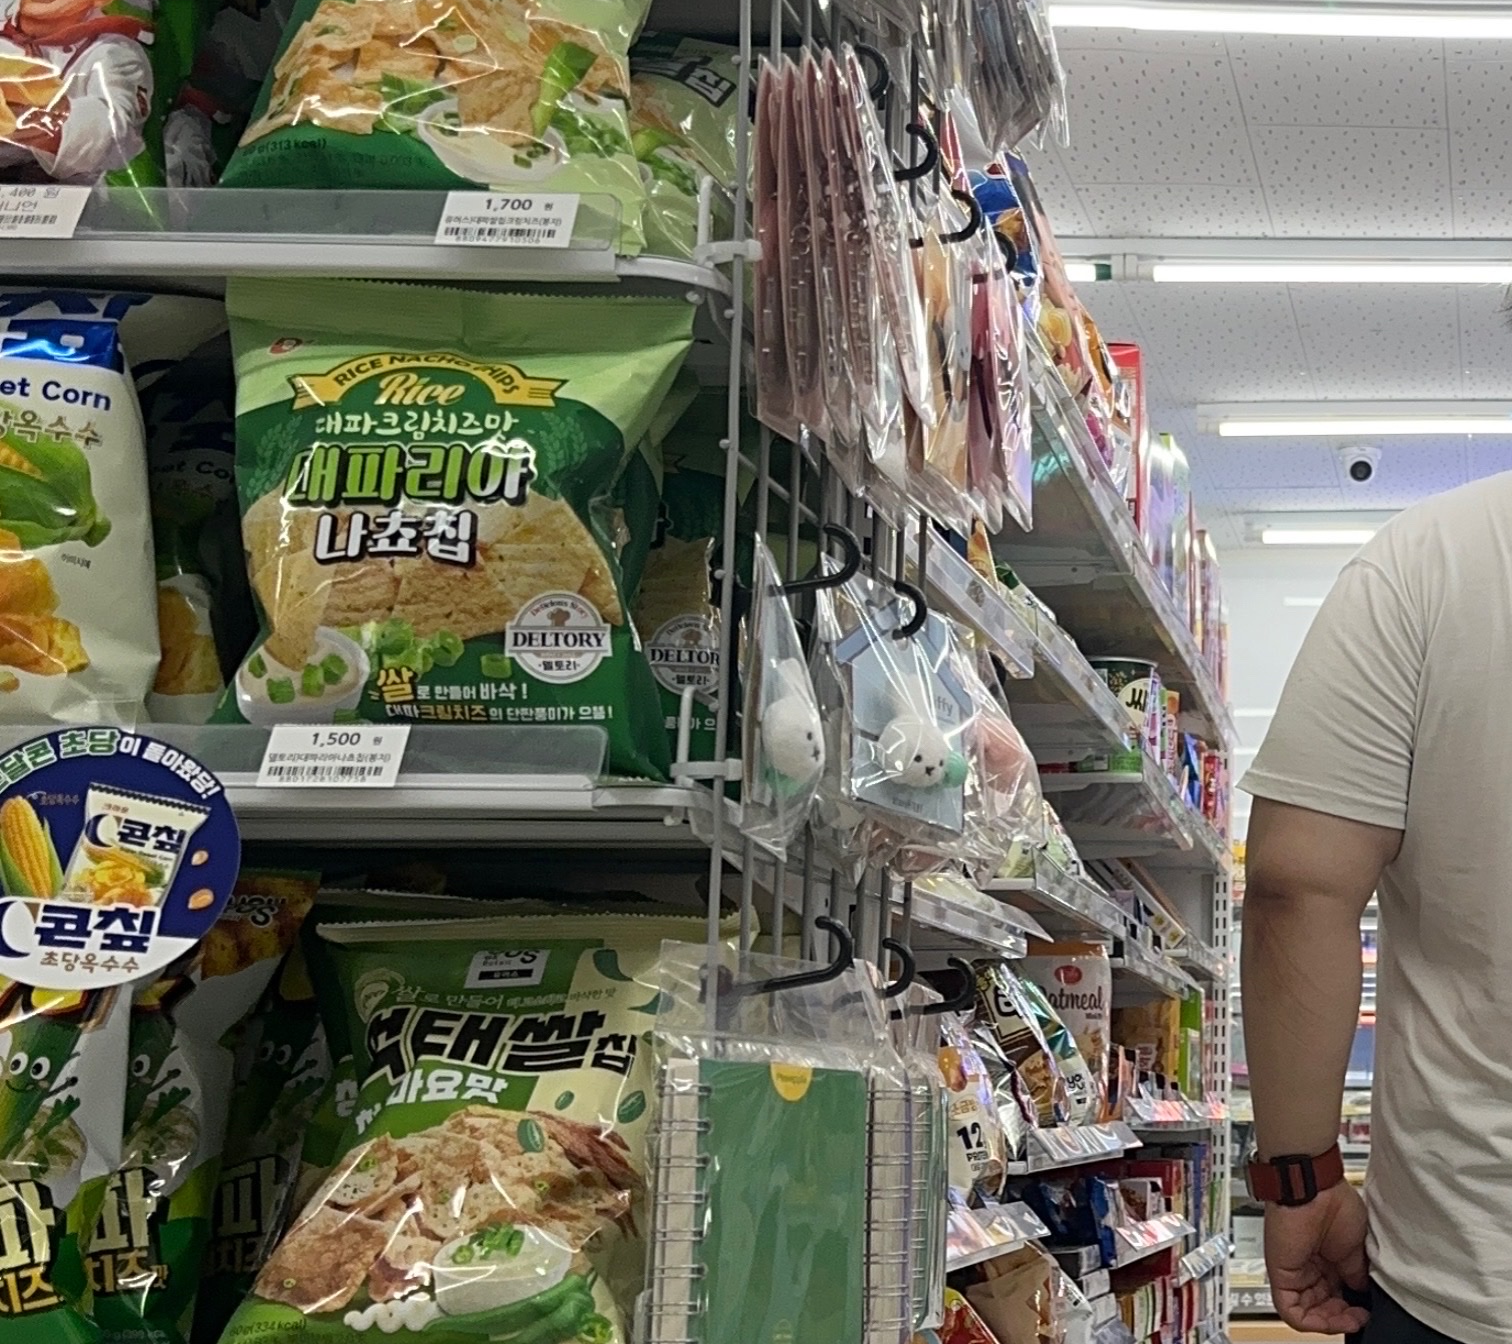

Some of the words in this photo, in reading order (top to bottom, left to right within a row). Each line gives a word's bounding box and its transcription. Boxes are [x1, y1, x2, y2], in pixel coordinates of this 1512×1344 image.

[485, 198, 533, 213] 1,700
[333, 357, 384, 388] RICE
[388, 351, 467, 368] NACHO
[42, 380, 112, 412] Corn
[373, 372, 466, 407] Rice
[314, 409, 520, 443] 대파크림치즈맛
[313, 510, 479, 567] 나쵸칩
[511, 630, 606, 649] DELTORY
[542, 658, 578, 673] 델토리
[434, 683, 477, 702] 만들어
[479, 680, 517, 702] 바삭
[311, 732, 361, 748] 1,500
[59, 727, 140, 756] 초당이
[142, 745, 220, 801] 돌아왔당!
[40, 949, 141, 974] 초당옥수수
[956, 1121, 985, 1151] 12
